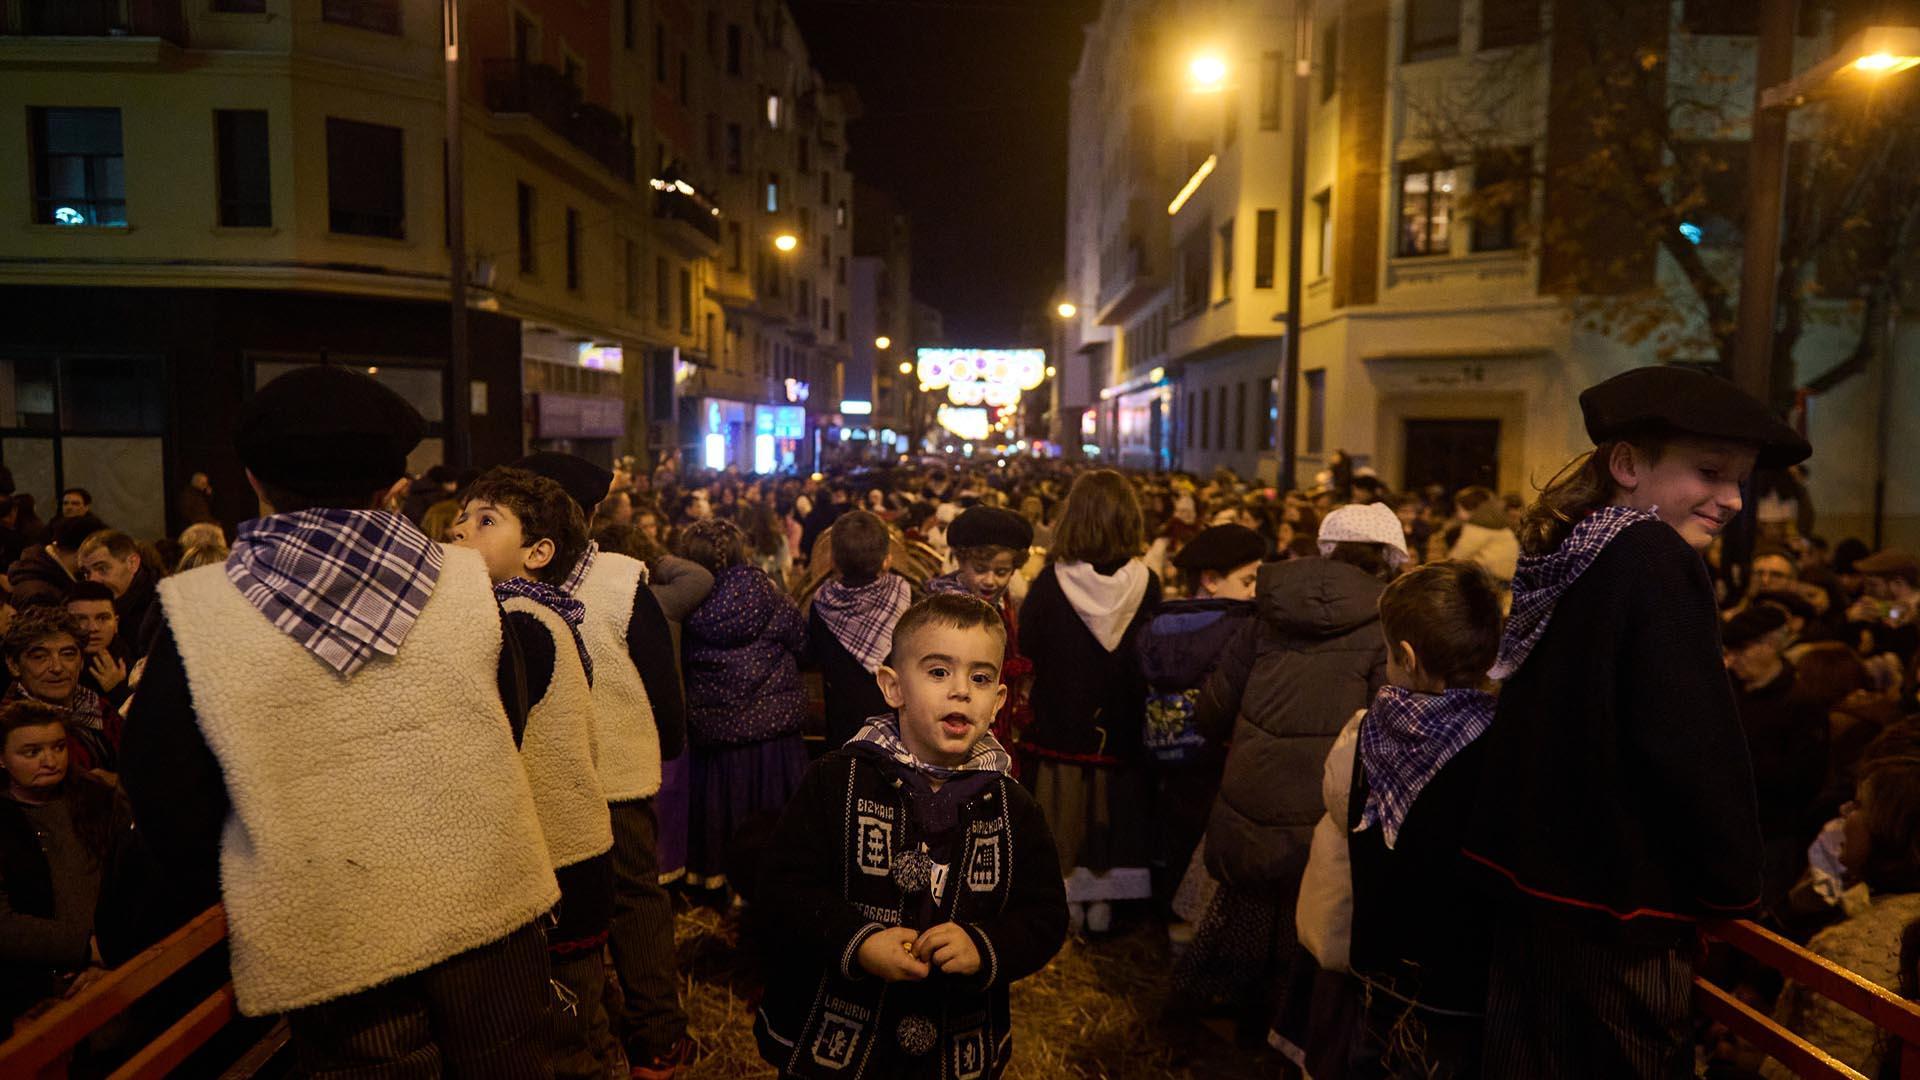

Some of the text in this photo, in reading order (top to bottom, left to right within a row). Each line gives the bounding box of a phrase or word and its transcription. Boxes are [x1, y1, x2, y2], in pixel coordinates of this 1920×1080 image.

[857, 798, 894, 820] BIZKAIA
[850, 901, 898, 924] FARROA
[824, 992, 871, 1022] LAPURDI
